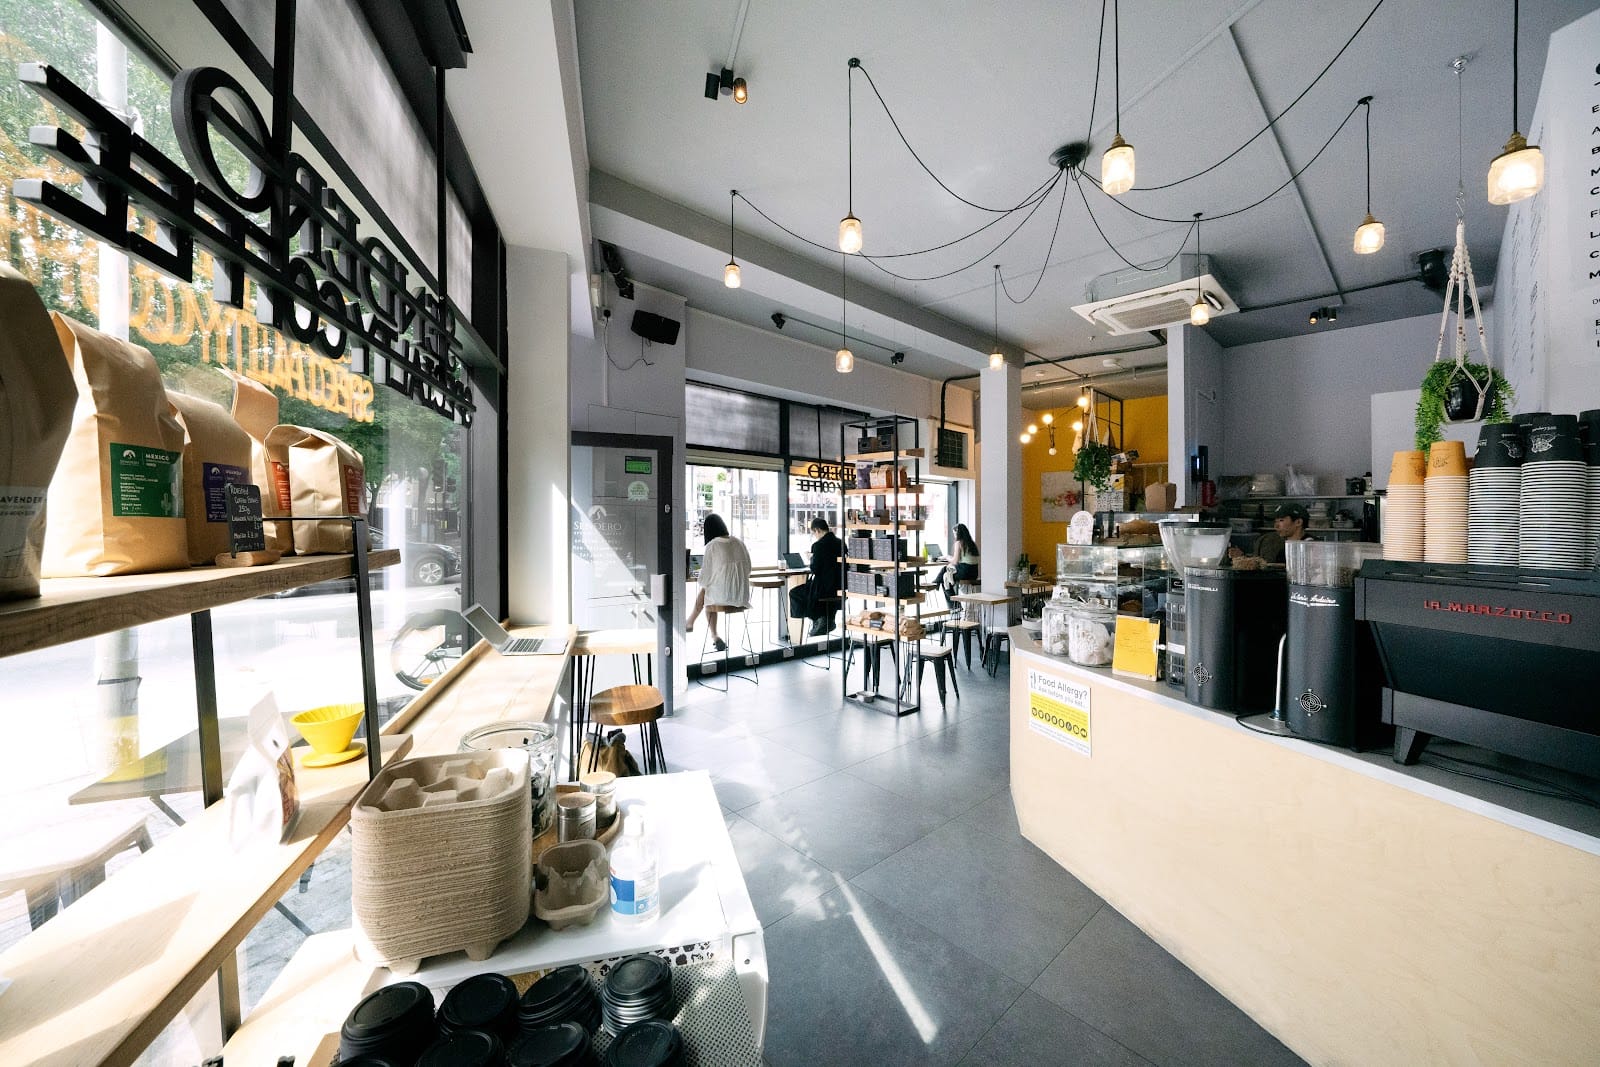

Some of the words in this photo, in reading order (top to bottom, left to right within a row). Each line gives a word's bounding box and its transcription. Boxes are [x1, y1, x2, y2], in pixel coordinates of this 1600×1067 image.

[0, 496, 43, 504] AVENDER
[573, 521, 622, 530] SEDERO
[1447, 601, 1572, 624] MARZOCCO
[1038, 675, 1056, 689] Food
[1058, 682, 1088, 700] Allergy?
